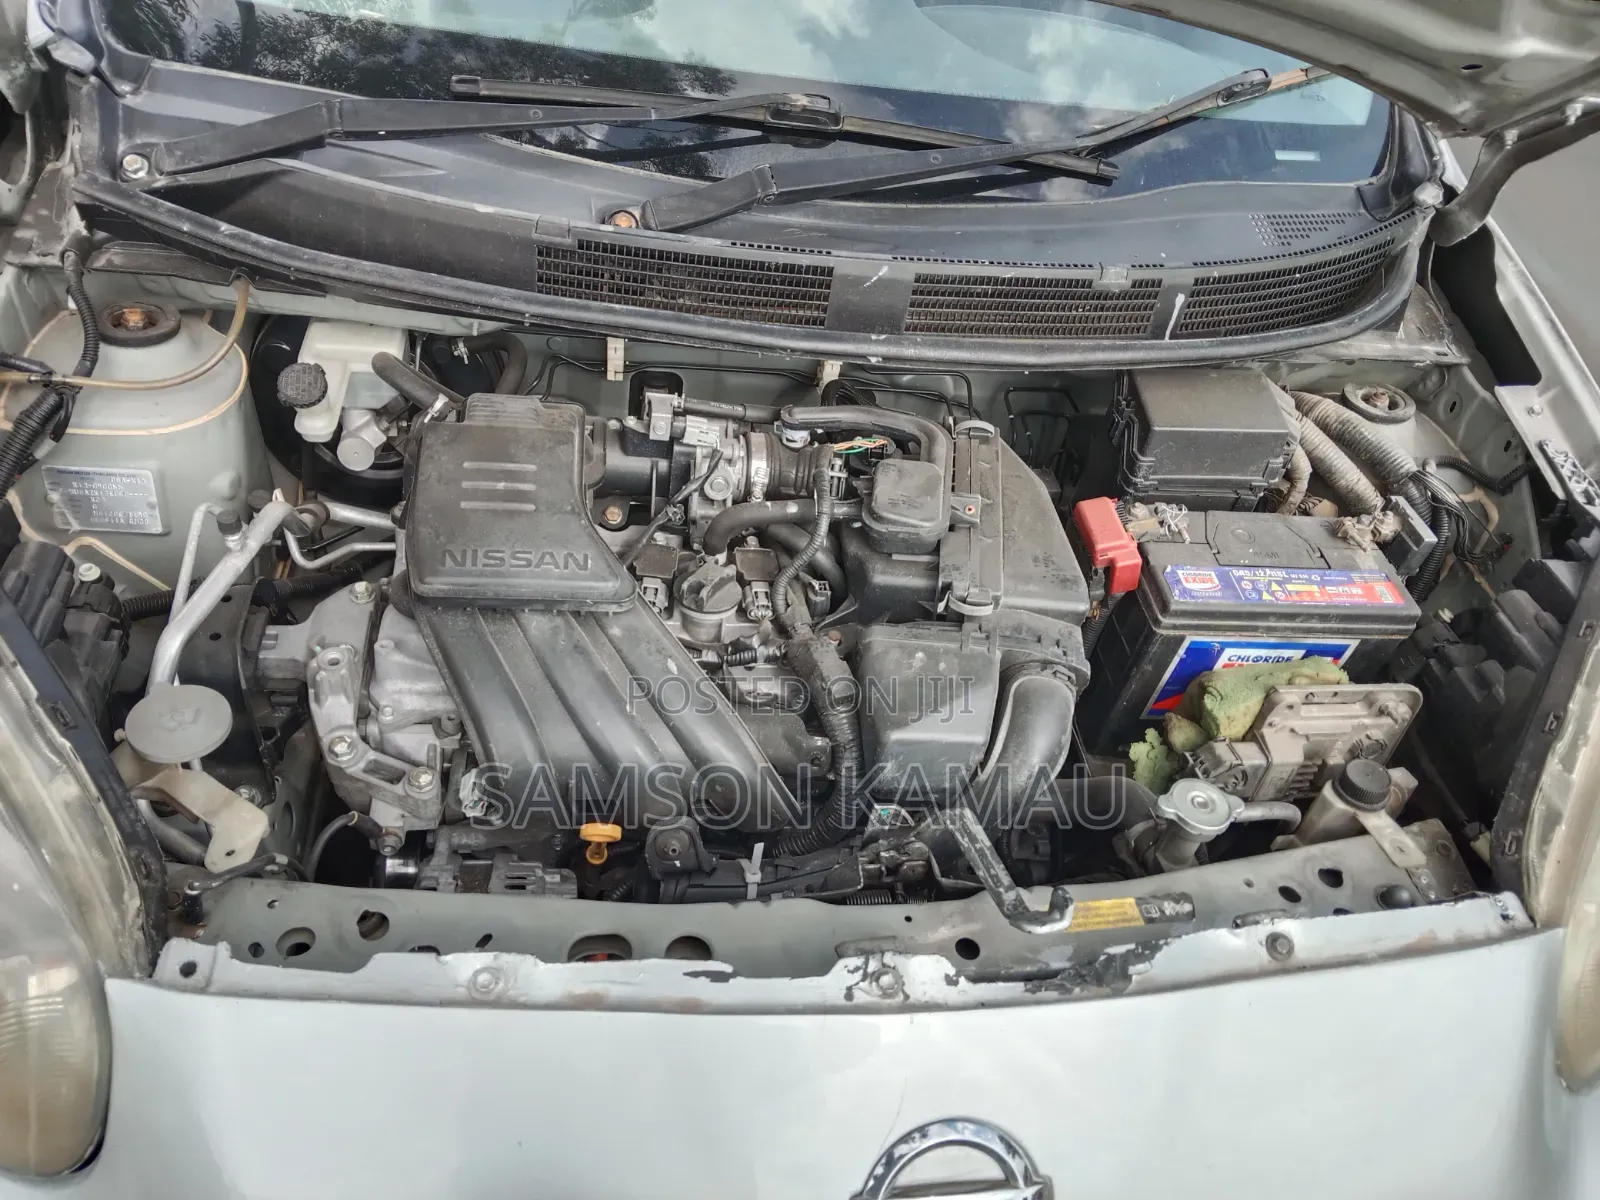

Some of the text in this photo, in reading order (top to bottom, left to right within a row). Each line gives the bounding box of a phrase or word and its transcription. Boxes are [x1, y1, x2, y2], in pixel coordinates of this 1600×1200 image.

[441, 549, 589, 571] NISSAN
[1183, 576, 1216, 584] EXIDE
[1227, 654, 1294, 664] CHLORIDE
